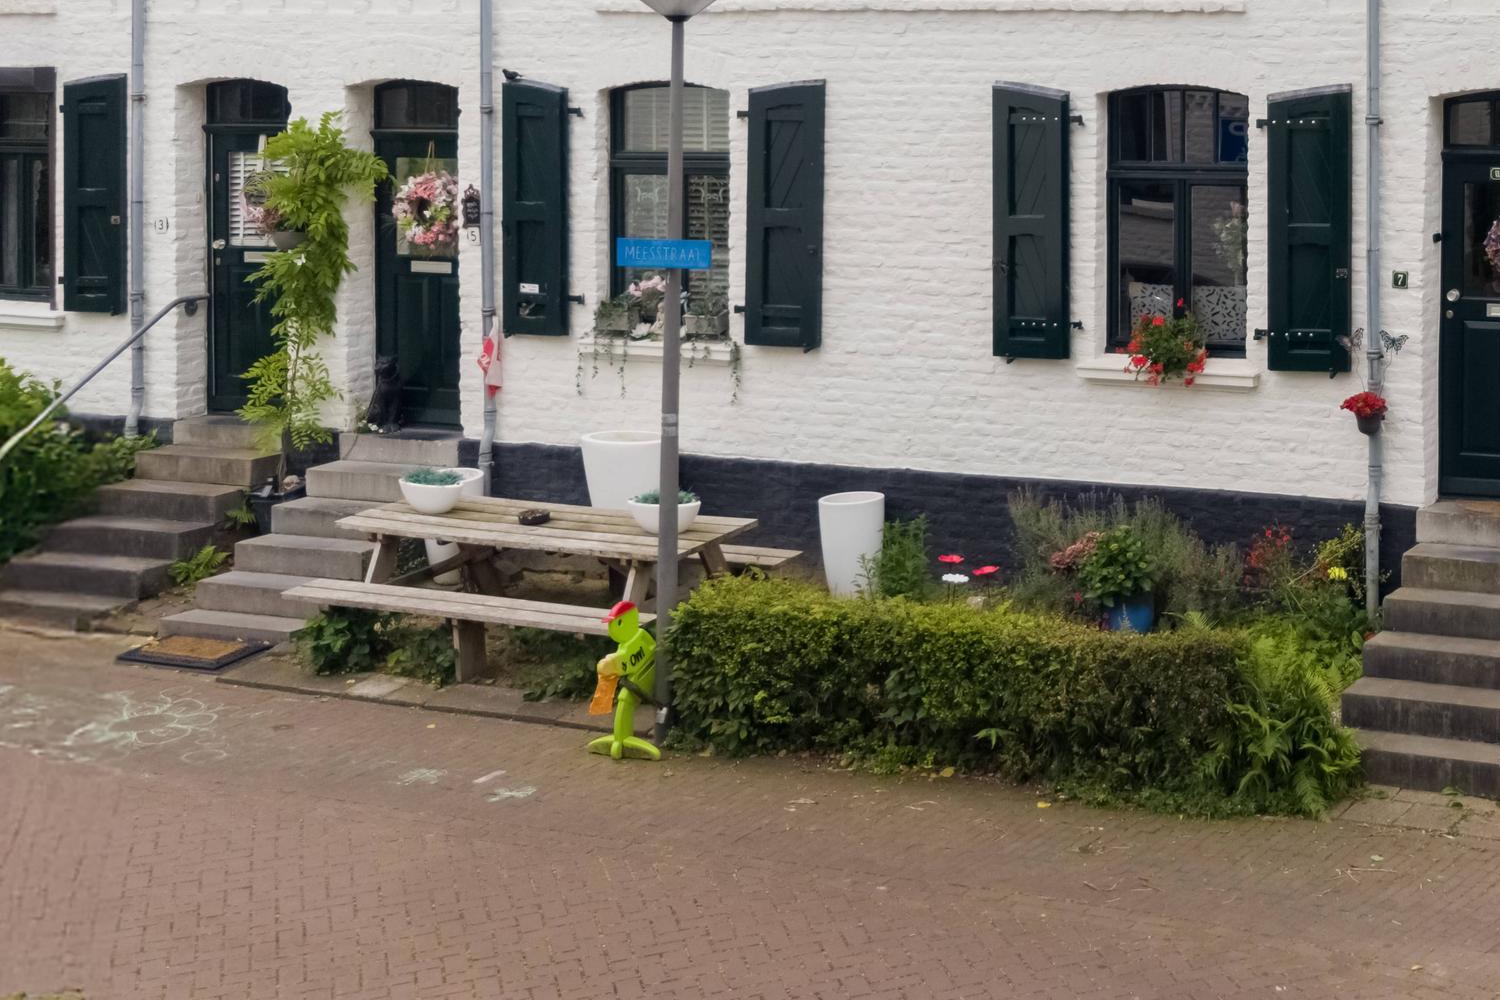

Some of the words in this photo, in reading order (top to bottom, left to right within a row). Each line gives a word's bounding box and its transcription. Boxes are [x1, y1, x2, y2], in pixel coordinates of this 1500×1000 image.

[158, 219, 164, 231] 3
[470, 230, 477, 242] 5
[1397, 274, 1404, 286] 7
